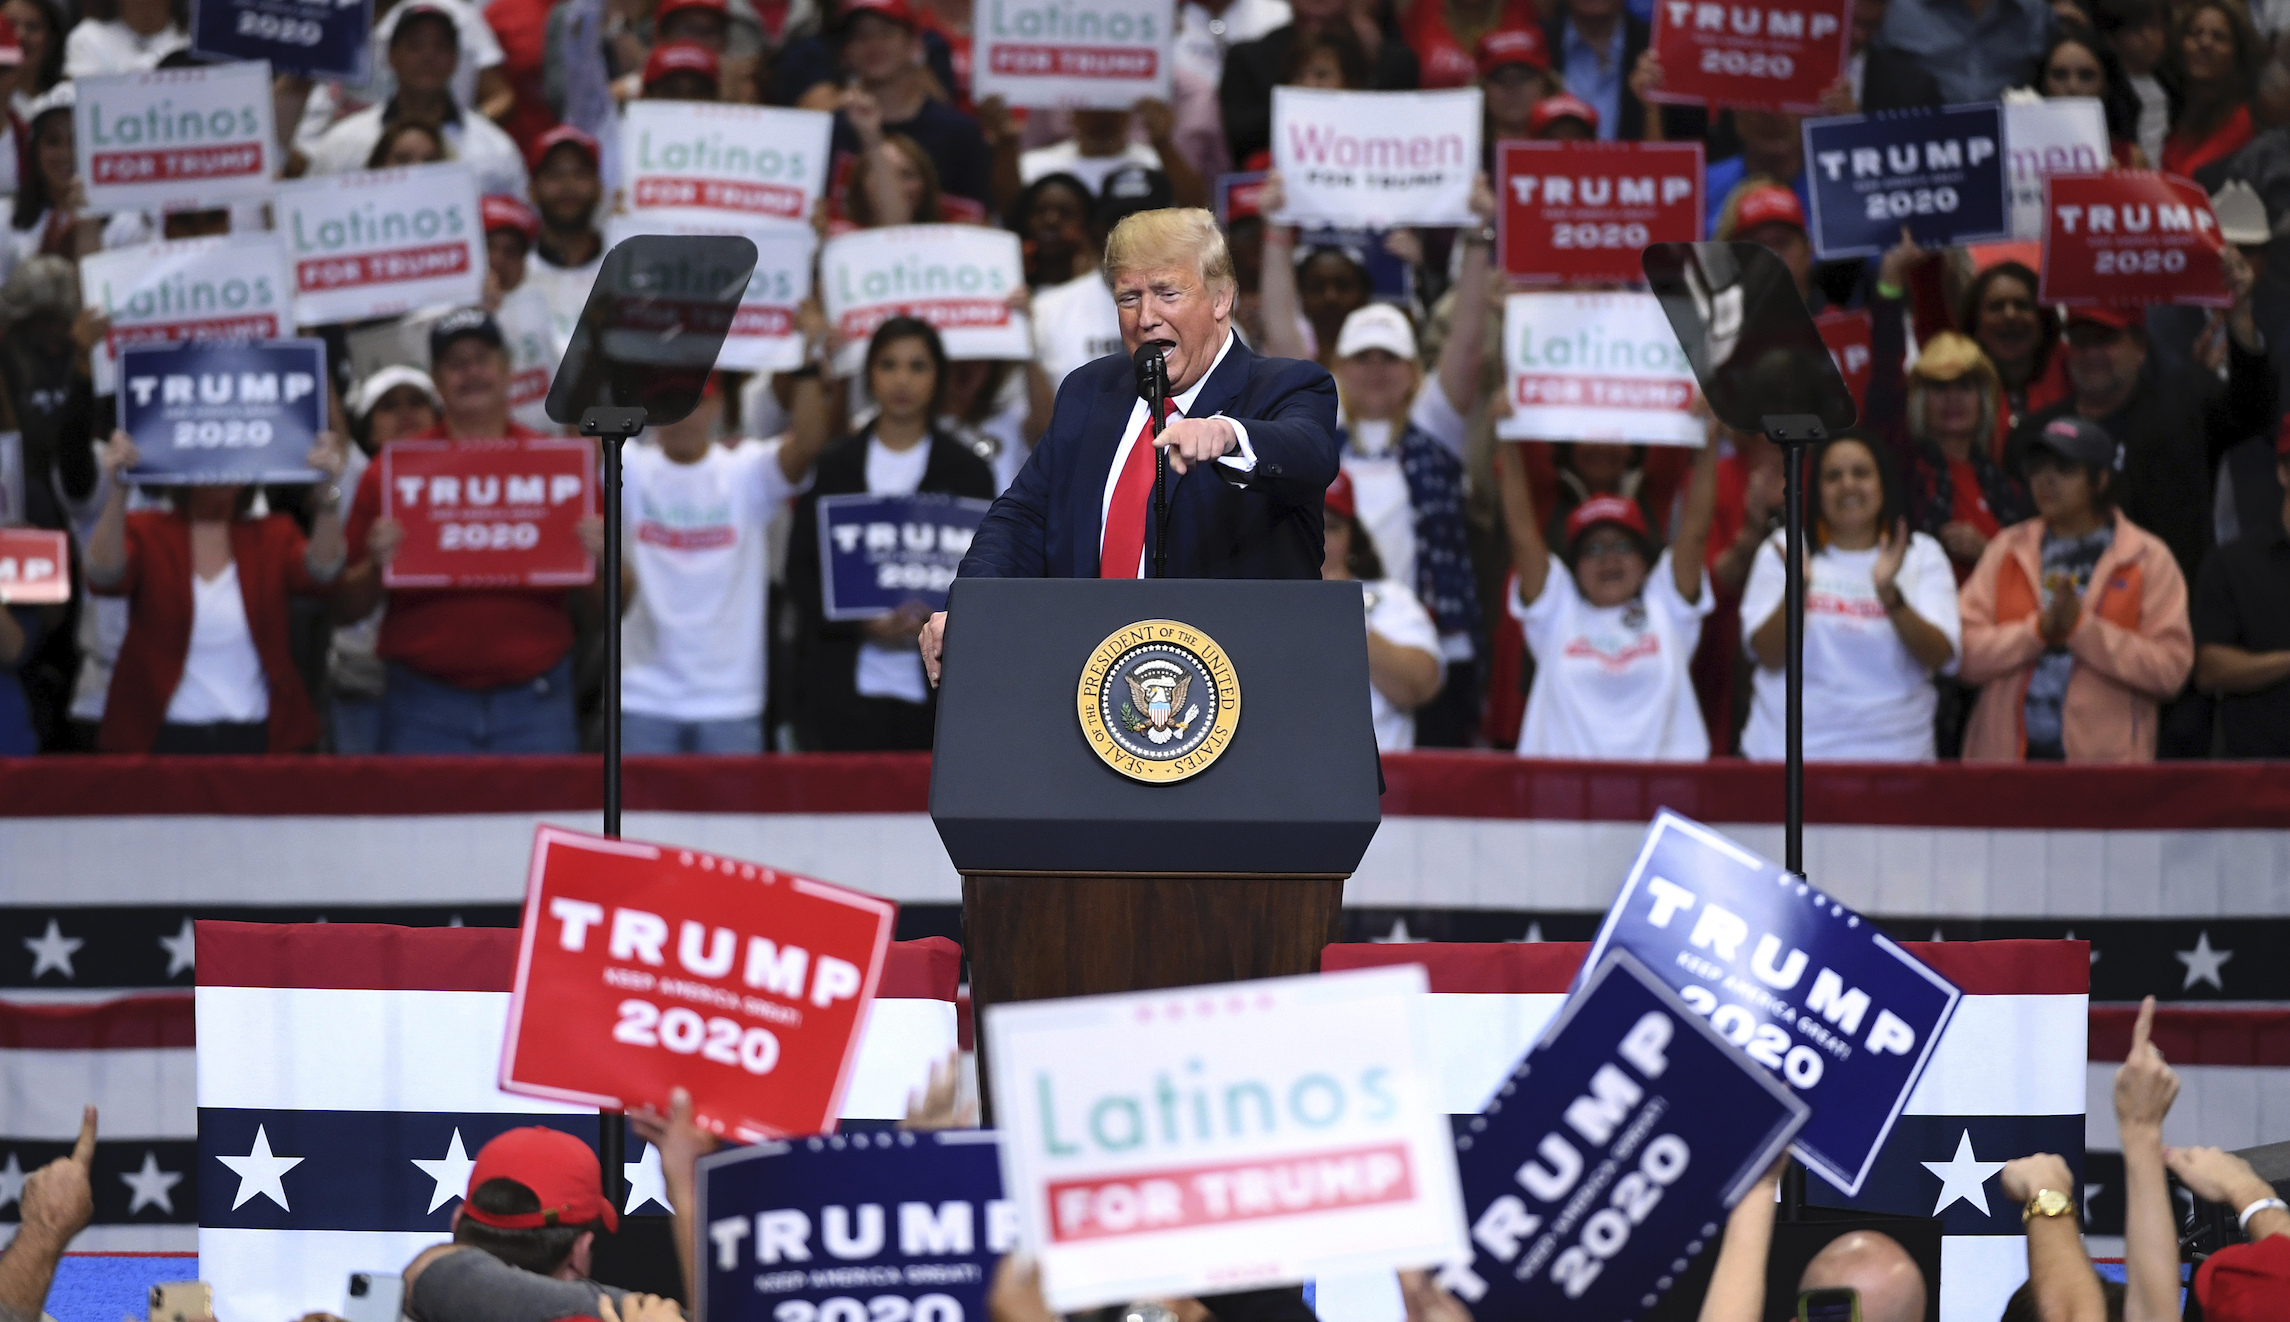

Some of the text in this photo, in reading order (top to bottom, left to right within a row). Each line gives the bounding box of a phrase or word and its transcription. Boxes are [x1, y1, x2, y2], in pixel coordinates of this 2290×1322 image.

[236, 9, 324, 47] 2020
[992, 0, 1158, 40] Latinos
[1667, 1, 1839, 39] TRUMP
[1061, 51, 1151, 73] TRUMP
[1702, 48, 1795, 79] 2020
[91, 101, 258, 145] Latinos
[99, 150, 257, 178] FOR TRUMP
[639, 130, 806, 178] Latinos
[1288, 123, 1464, 168] Women
[1817, 136, 1996, 182] TRUMP
[1365, 170, 1444, 189] TRUMP
[1510, 175, 1693, 205] TRUMP
[1866, 187, 1960, 221] 2020
[2056, 203, 2215, 235] TRUMP
[293, 202, 465, 251] Latinos
[1551, 222, 1649, 249] 2020
[302, 251, 461, 286] FOR TRUMP
[837, 254, 1006, 302] Latinos
[2094, 249, 2187, 276] 2020
[104, 271, 273, 320] Latinos
[128, 372, 315, 407] TRUMP
[1522, 380, 1688, 407] FOR TRUMP
[174, 420, 273, 448] 2020
[396, 474, 582, 506] TRUMP
[439, 522, 540, 550] 2020
[832, 522, 977, 554] TRUM
[1083, 626, 1235, 774] SEAL OF THE PRESIDENT OF THE UNITED STATES
[549, 896, 862, 1009] TRUMP
[1646, 874, 1916, 1057] TRUMP
[602, 965, 804, 1030] KEEP AMERICA GREAT!
[1675, 950, 1852, 1062] KEEP AMERICA GREAT!
[612, 998, 780, 1076] 2020
[1679, 984, 1824, 1090] 2020
[1032, 1054, 1400, 1159] Latinos
[1436, 1009, 1676, 1304] TRUMP
[1057, 1153, 1403, 1235] FOR TRUMP
[1549, 1132, 1692, 1300] 2020
[753, 1262, 983, 1294] KEEP AMERICA GREAT!
[772, 1292, 966, 1322] 2020
